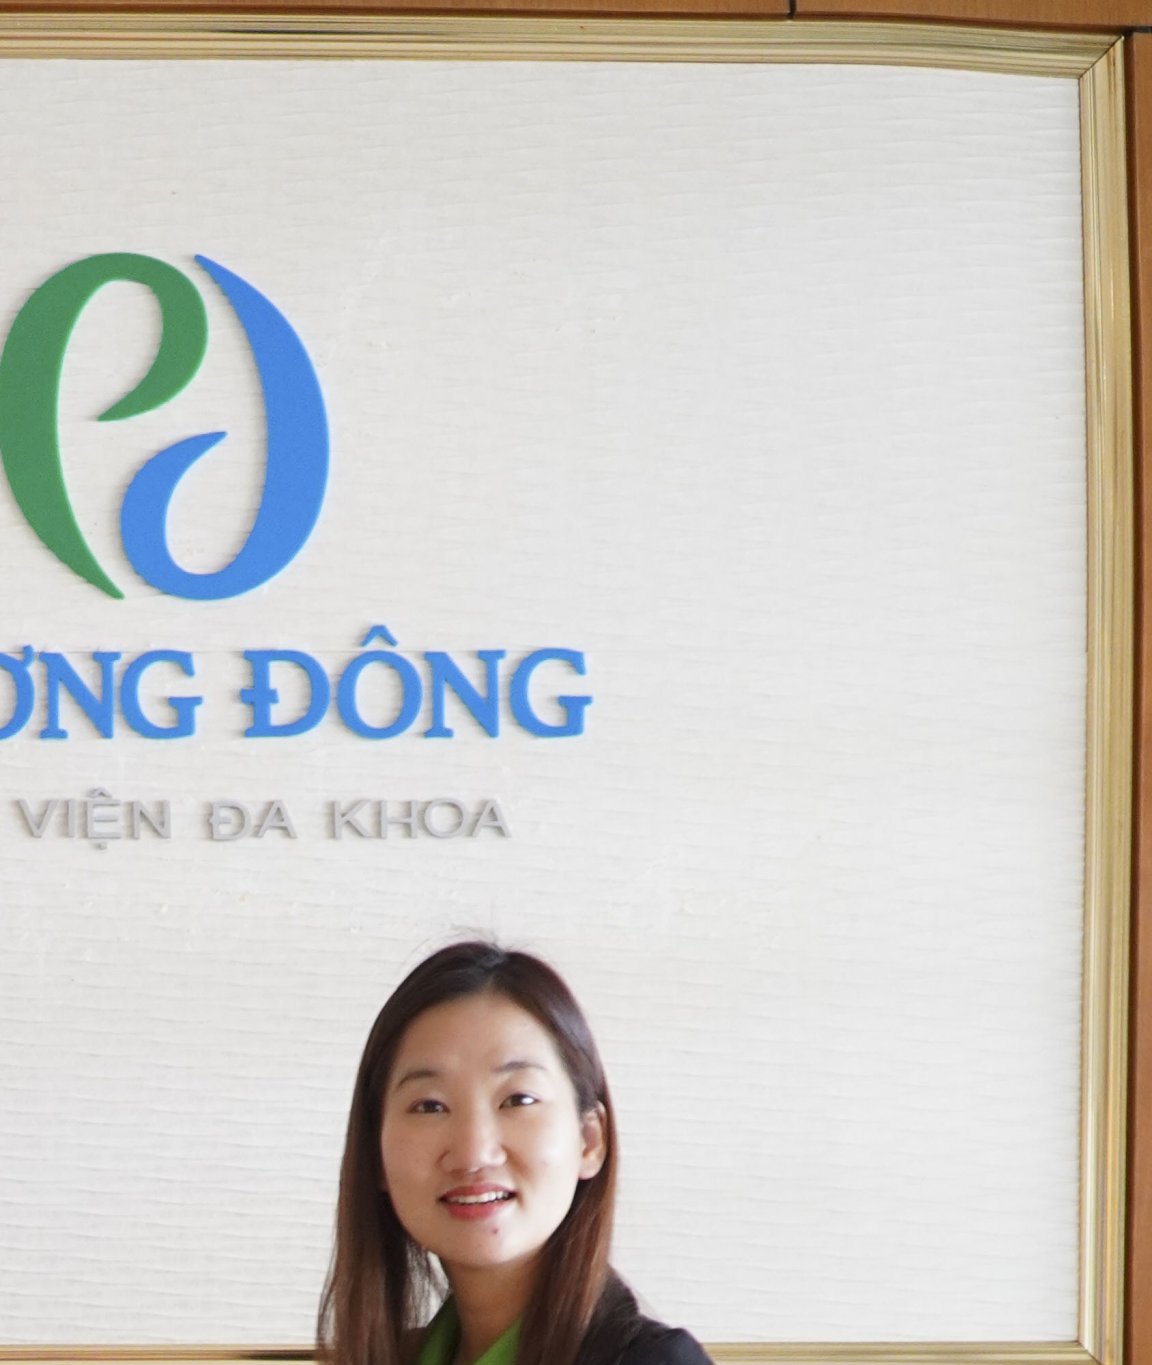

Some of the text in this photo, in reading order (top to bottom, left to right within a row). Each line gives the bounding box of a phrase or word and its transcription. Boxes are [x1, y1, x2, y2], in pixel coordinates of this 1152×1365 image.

[239, 625, 593, 740] ĐÔNG
[15, 787, 171, 851] VIỆN
[209, 799, 297, 841] ĐA
[332, 799, 511, 839] KHOA
